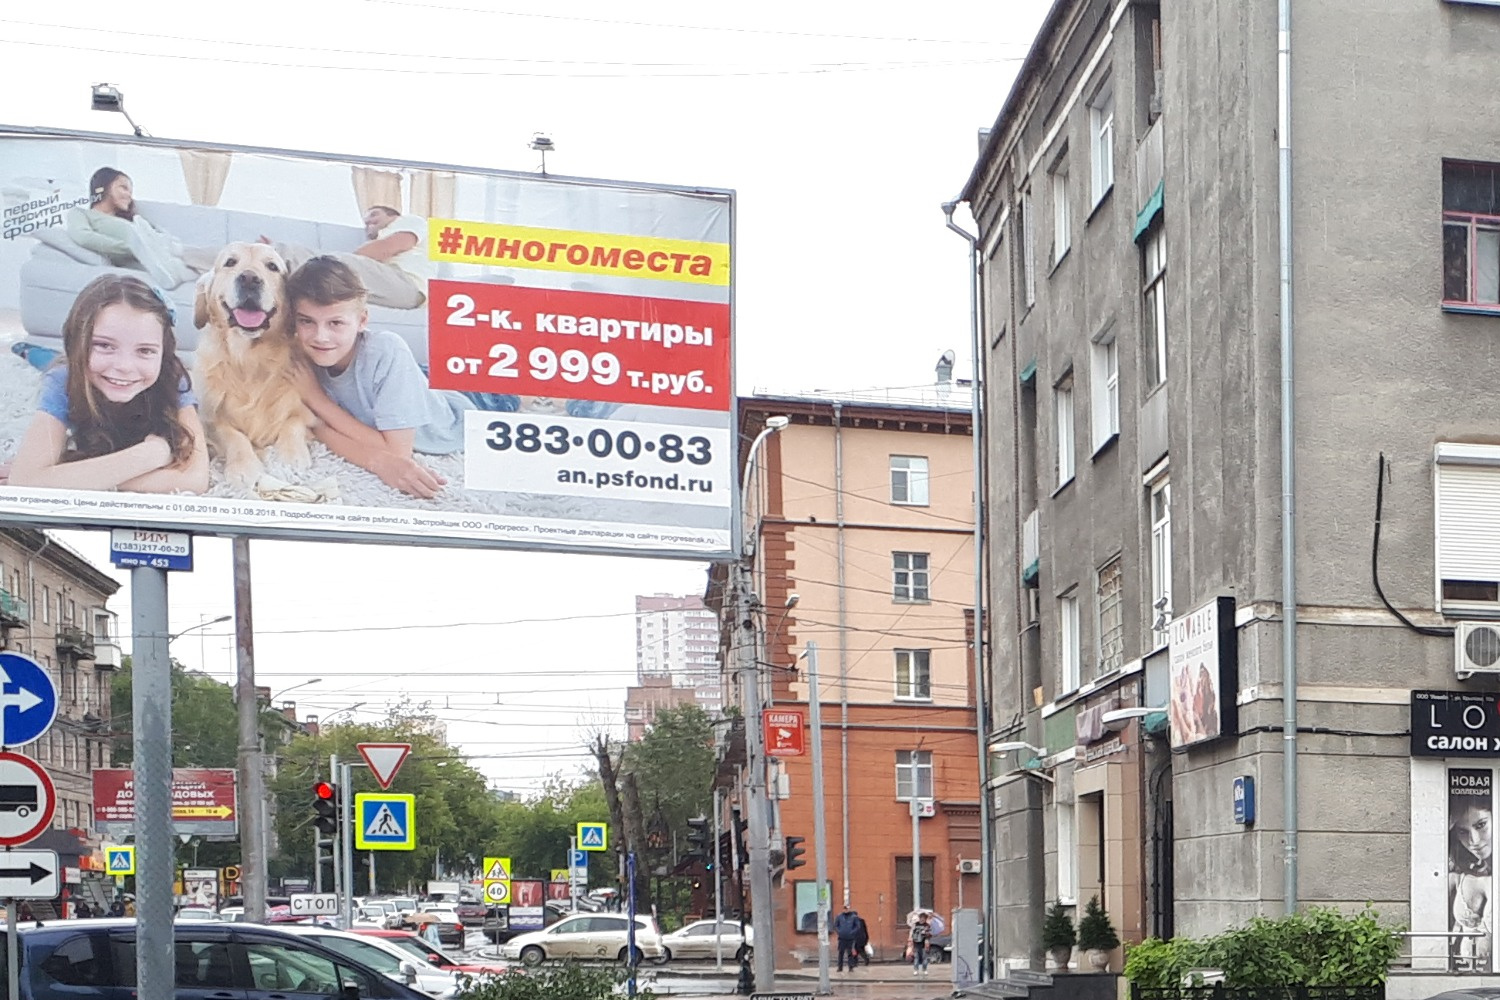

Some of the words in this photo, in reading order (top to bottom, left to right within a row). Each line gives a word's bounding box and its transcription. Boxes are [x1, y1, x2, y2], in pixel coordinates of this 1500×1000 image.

[3, 189, 60, 219] первый
[3, 191, 103, 228] строительный
[3, 213, 63, 241] фонд
[437, 226, 713, 277] #многоместа
[446, 294, 522, 331] 2-к.
[535, 312, 713, 348] квартиры
[446, 355, 482, 375] от
[528, 347, 621, 386] 999
[627, 370, 713, 394] т.руб.
[557, 469, 713, 493] an.psfond.ru
[173, 504, 218, 515] 01.08.2018
[220, 507, 229, 515] по
[280, 510, 334, 521] Подробности
[347, 514, 370, 523] сайте
[462, 520, 482, 529] ООО
[533, 525, 577, 536] Проектные
[113, 542, 186, 554] 8(383)217-00-20
[133, 531, 169, 543] РИМ
[150, 558, 170, 567] 453
[1427, 735, 1488, 751] салон
[1451, 776, 1490, 786] НОВАЯ
[489, 887, 502, 896] 40
